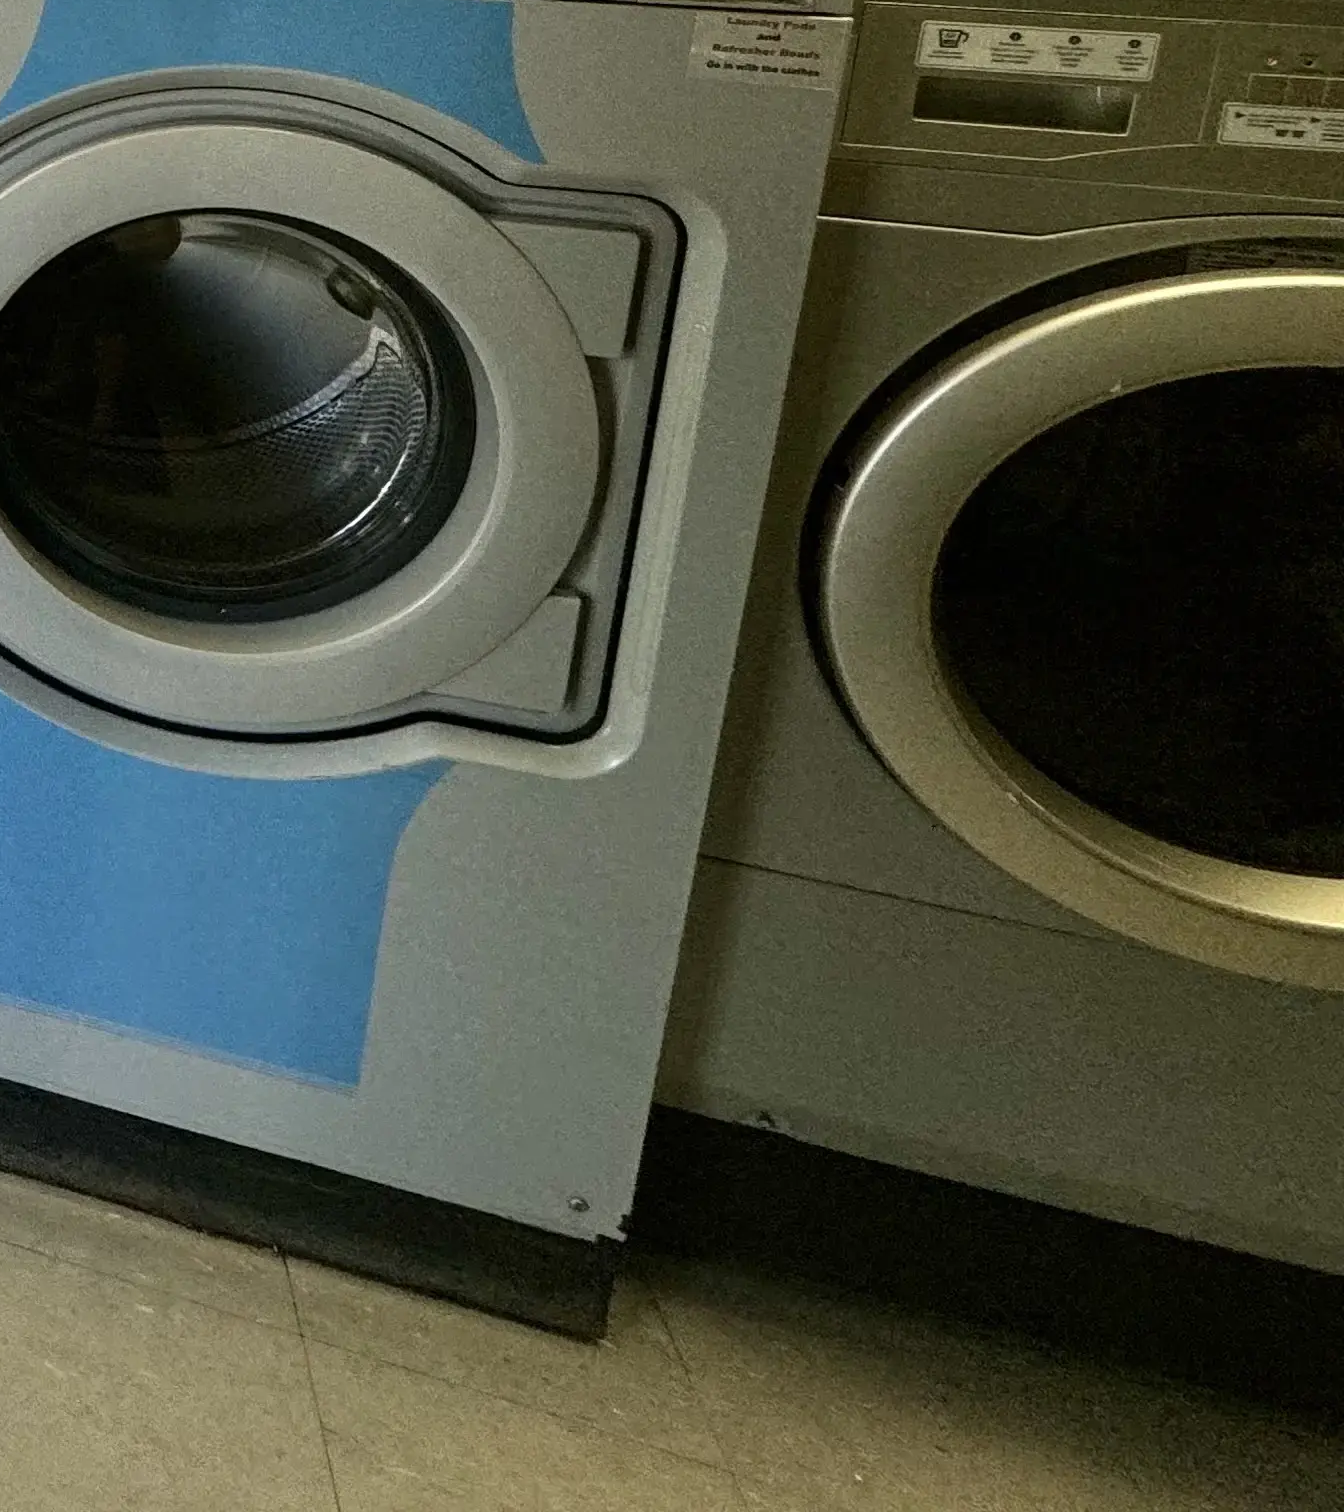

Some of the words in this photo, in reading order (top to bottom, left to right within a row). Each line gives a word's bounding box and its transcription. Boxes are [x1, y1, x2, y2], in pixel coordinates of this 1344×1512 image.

[727, 17, 780, 29] Laundry
[712, 43, 777, 56] Refresher
[723, 61, 734, 69] in
[735, 63, 759, 72] with
[761, 65, 779, 73] the
